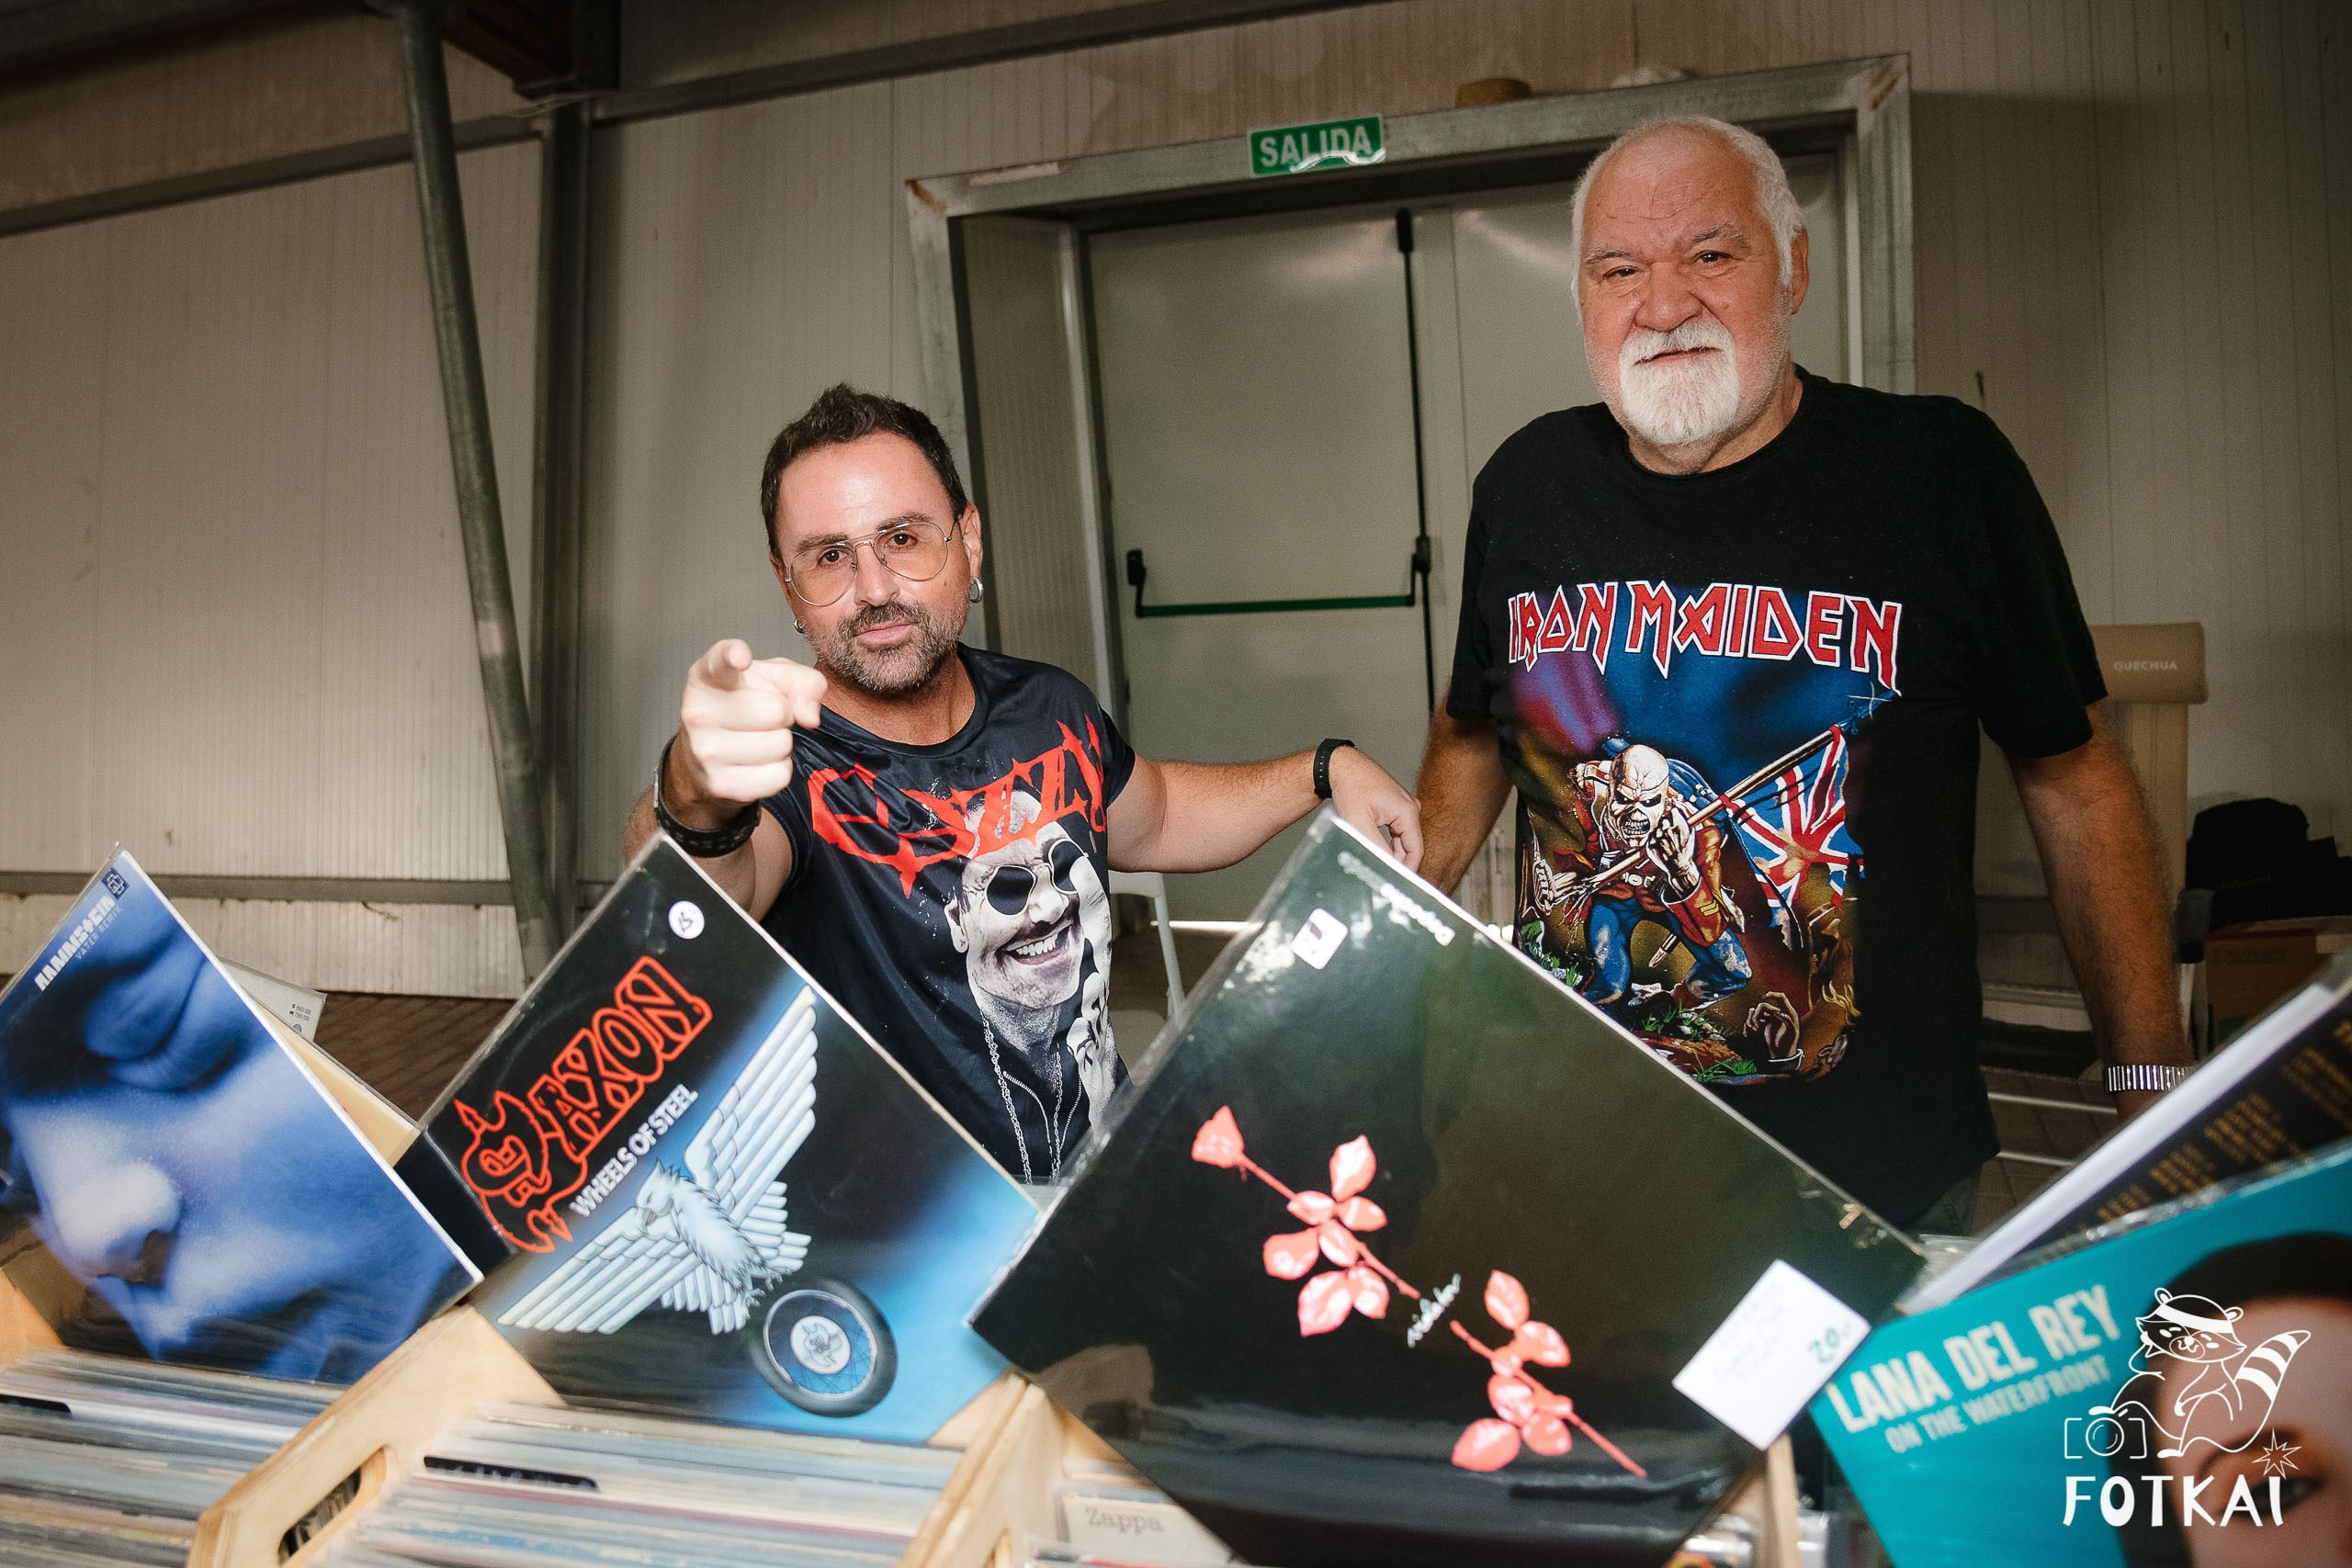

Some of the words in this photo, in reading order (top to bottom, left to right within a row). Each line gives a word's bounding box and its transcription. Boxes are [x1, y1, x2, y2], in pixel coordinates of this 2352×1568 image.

[1260, 125, 1374, 167] SALIDA
[1508, 581, 1618, 675] IRON
[1624, 580, 1903, 697] MAIDEN
[2113, 660, 2177, 671] QUECHUA
[808, 714, 1106, 899] OZZY
[34, 893, 116, 992] RAMMSTEIN
[74, 932, 99, 960] VATER
[97, 903, 122, 932] REMIX
[453, 955, 713, 1253] SAXON
[569, 1146, 638, 1217] WHEELS
[628, 1122, 657, 1156] OF
[648, 1084, 699, 1135] STEEL
[1825, 1350, 1953, 1434] LANA
[1942, 1321, 2038, 1391] DEL
[2028, 1284, 2120, 1360] REY
[1885, 1422, 1923, 1453] ON
[1917, 1404, 1968, 1441] THE
[1961, 1354, 2111, 1425] WATERFRONT
[1084, 1506, 1165, 1535] Zappa
